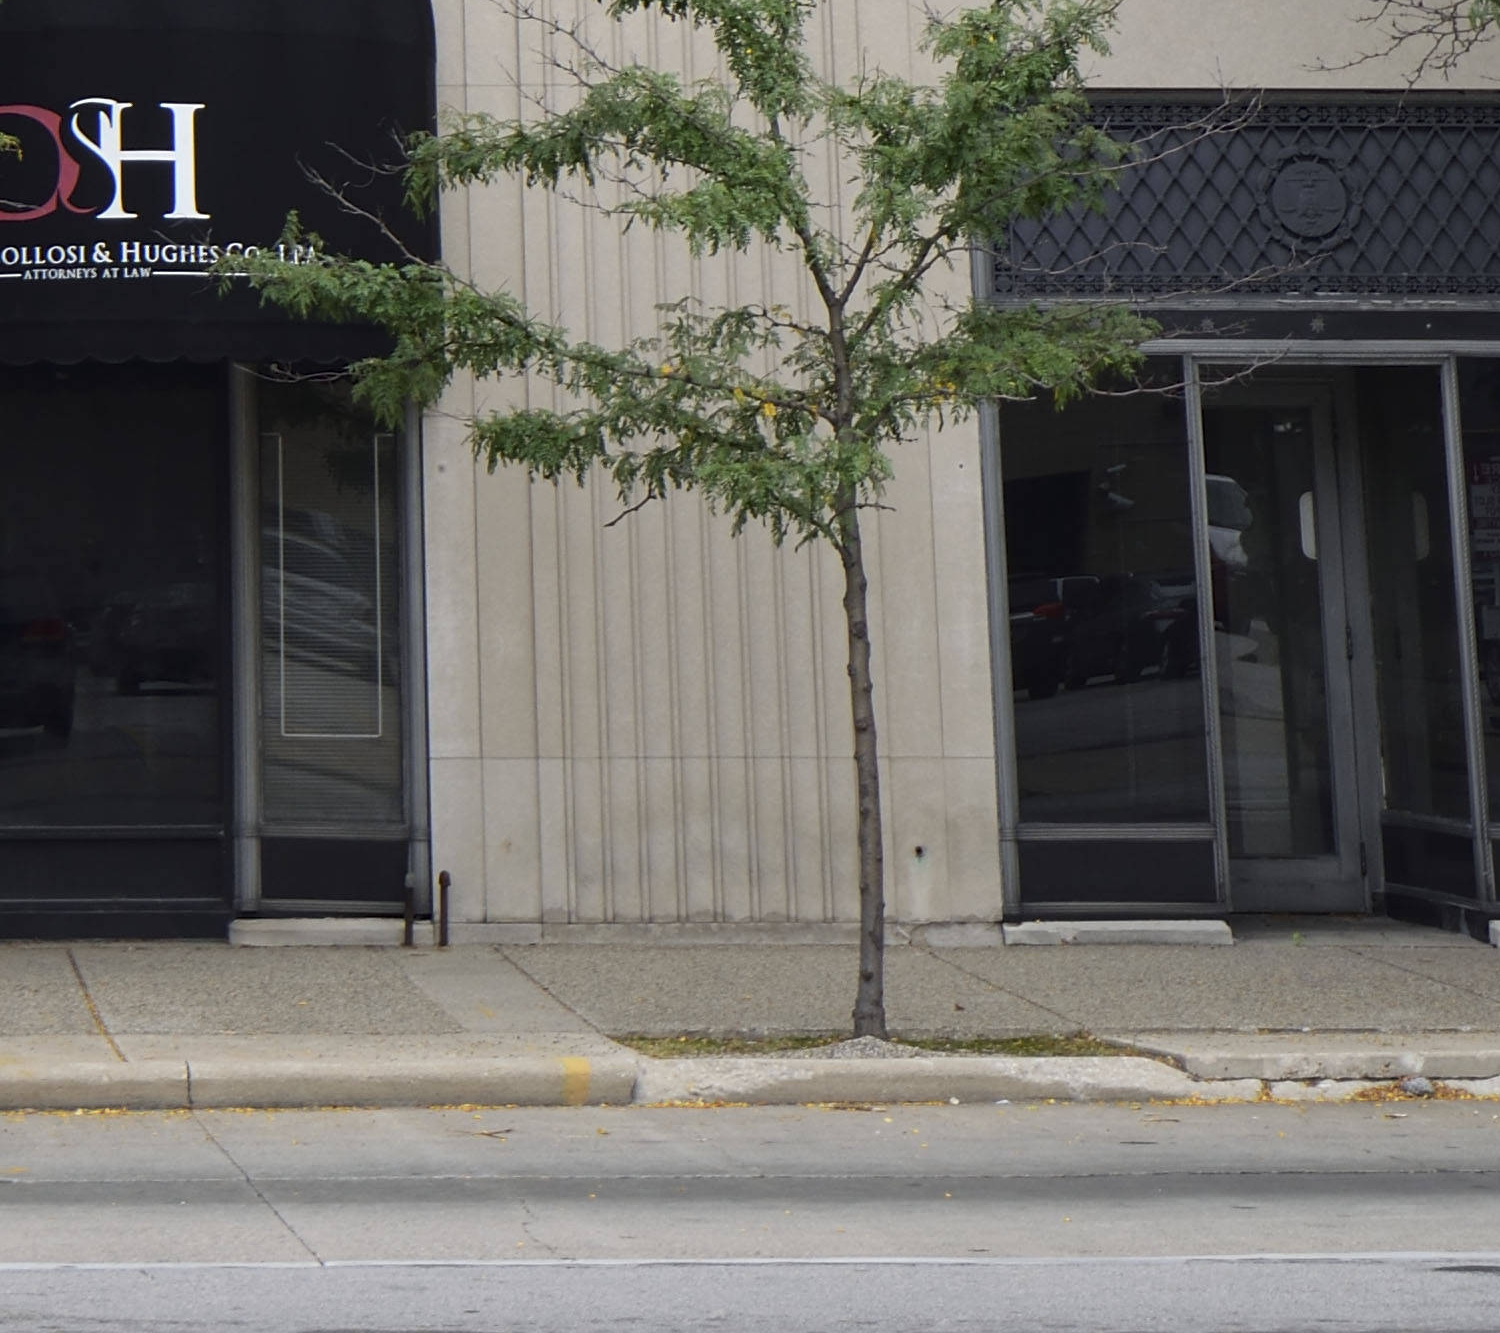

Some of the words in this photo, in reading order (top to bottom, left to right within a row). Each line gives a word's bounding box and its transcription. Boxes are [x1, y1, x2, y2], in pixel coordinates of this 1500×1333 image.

[93, 241, 113, 264] &
[121, 241, 219, 264] HUGHES
[24, 267, 98, 280] ATTORNEYS
[102, 267, 119, 279] AT
[123, 267, 152, 278] LAW
